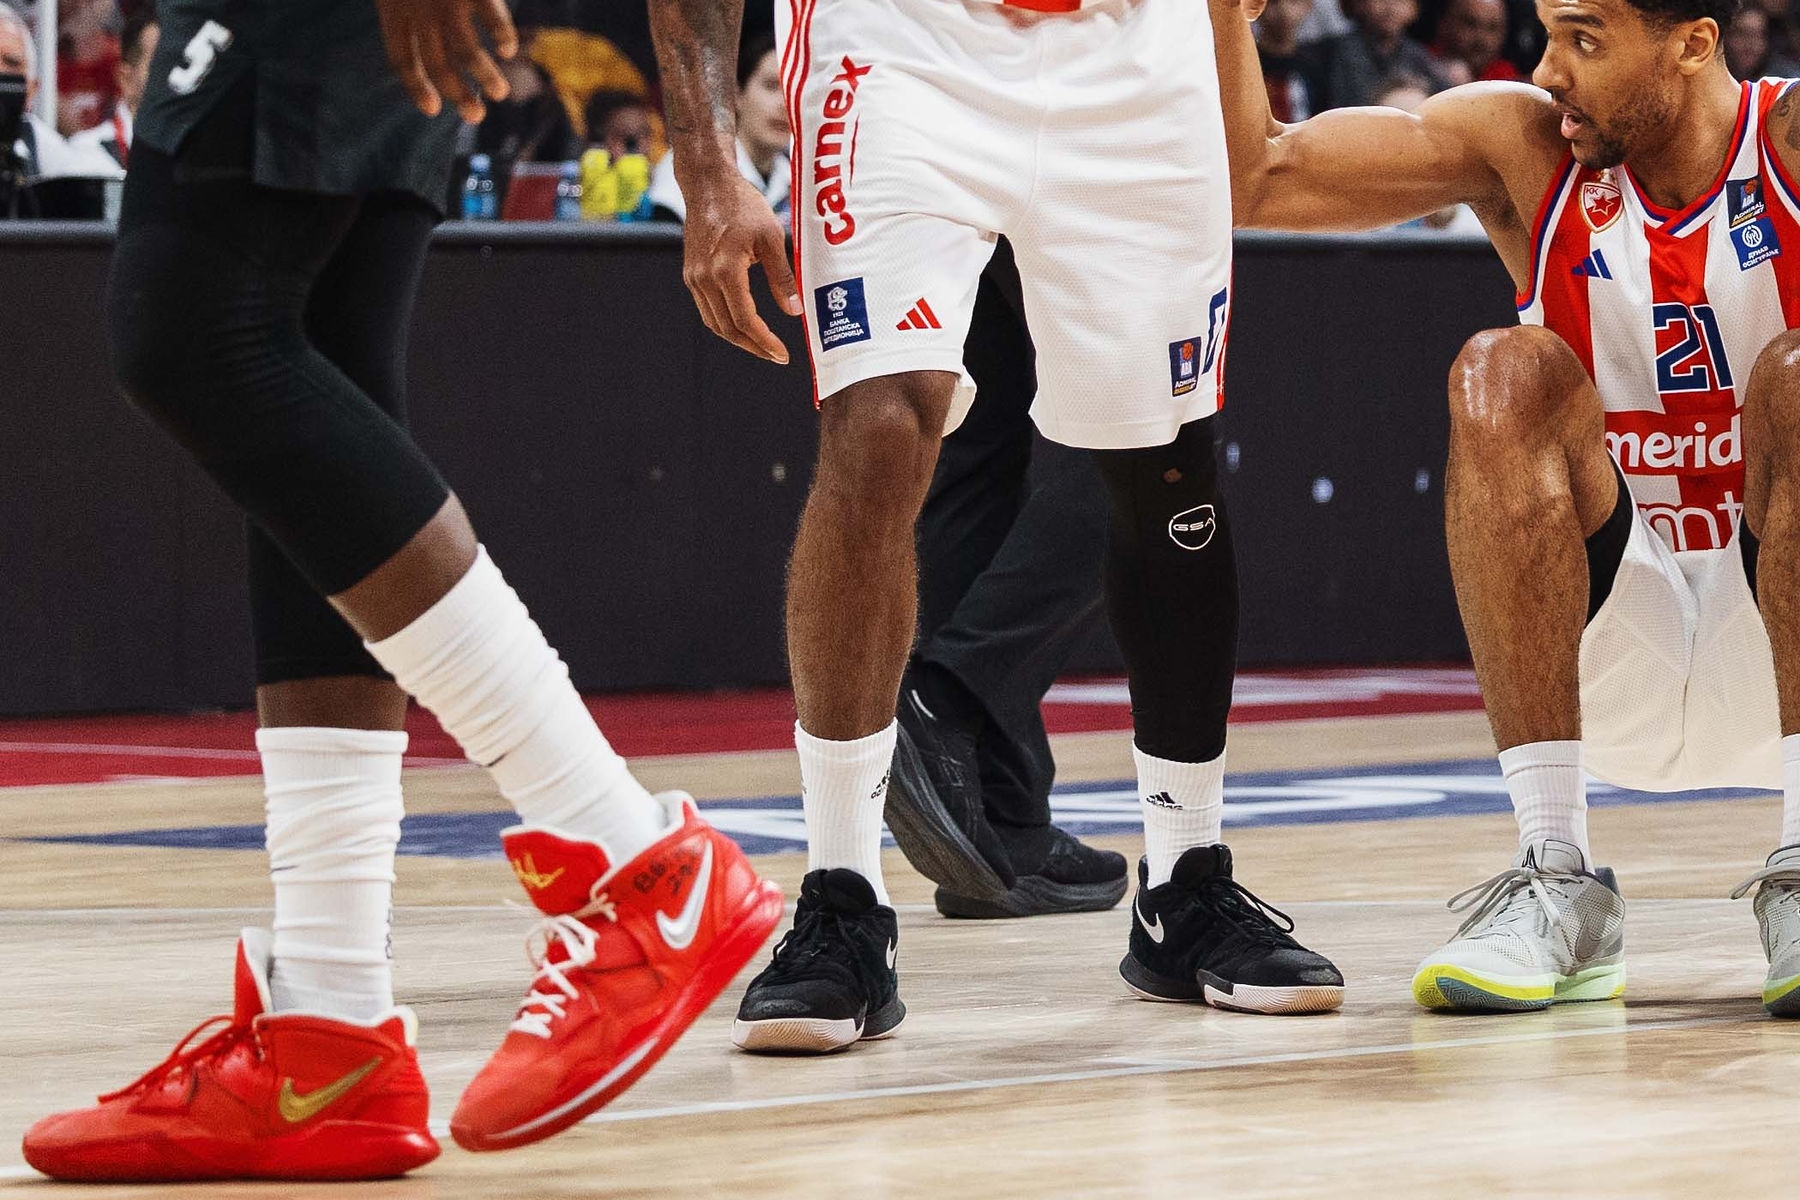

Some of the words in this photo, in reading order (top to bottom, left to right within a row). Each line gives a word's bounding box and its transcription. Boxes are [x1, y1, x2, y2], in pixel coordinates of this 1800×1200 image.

[168, 19, 234, 96] 5
[814, 55, 874, 246] carnex
[1651, 302, 1736, 394] 21
